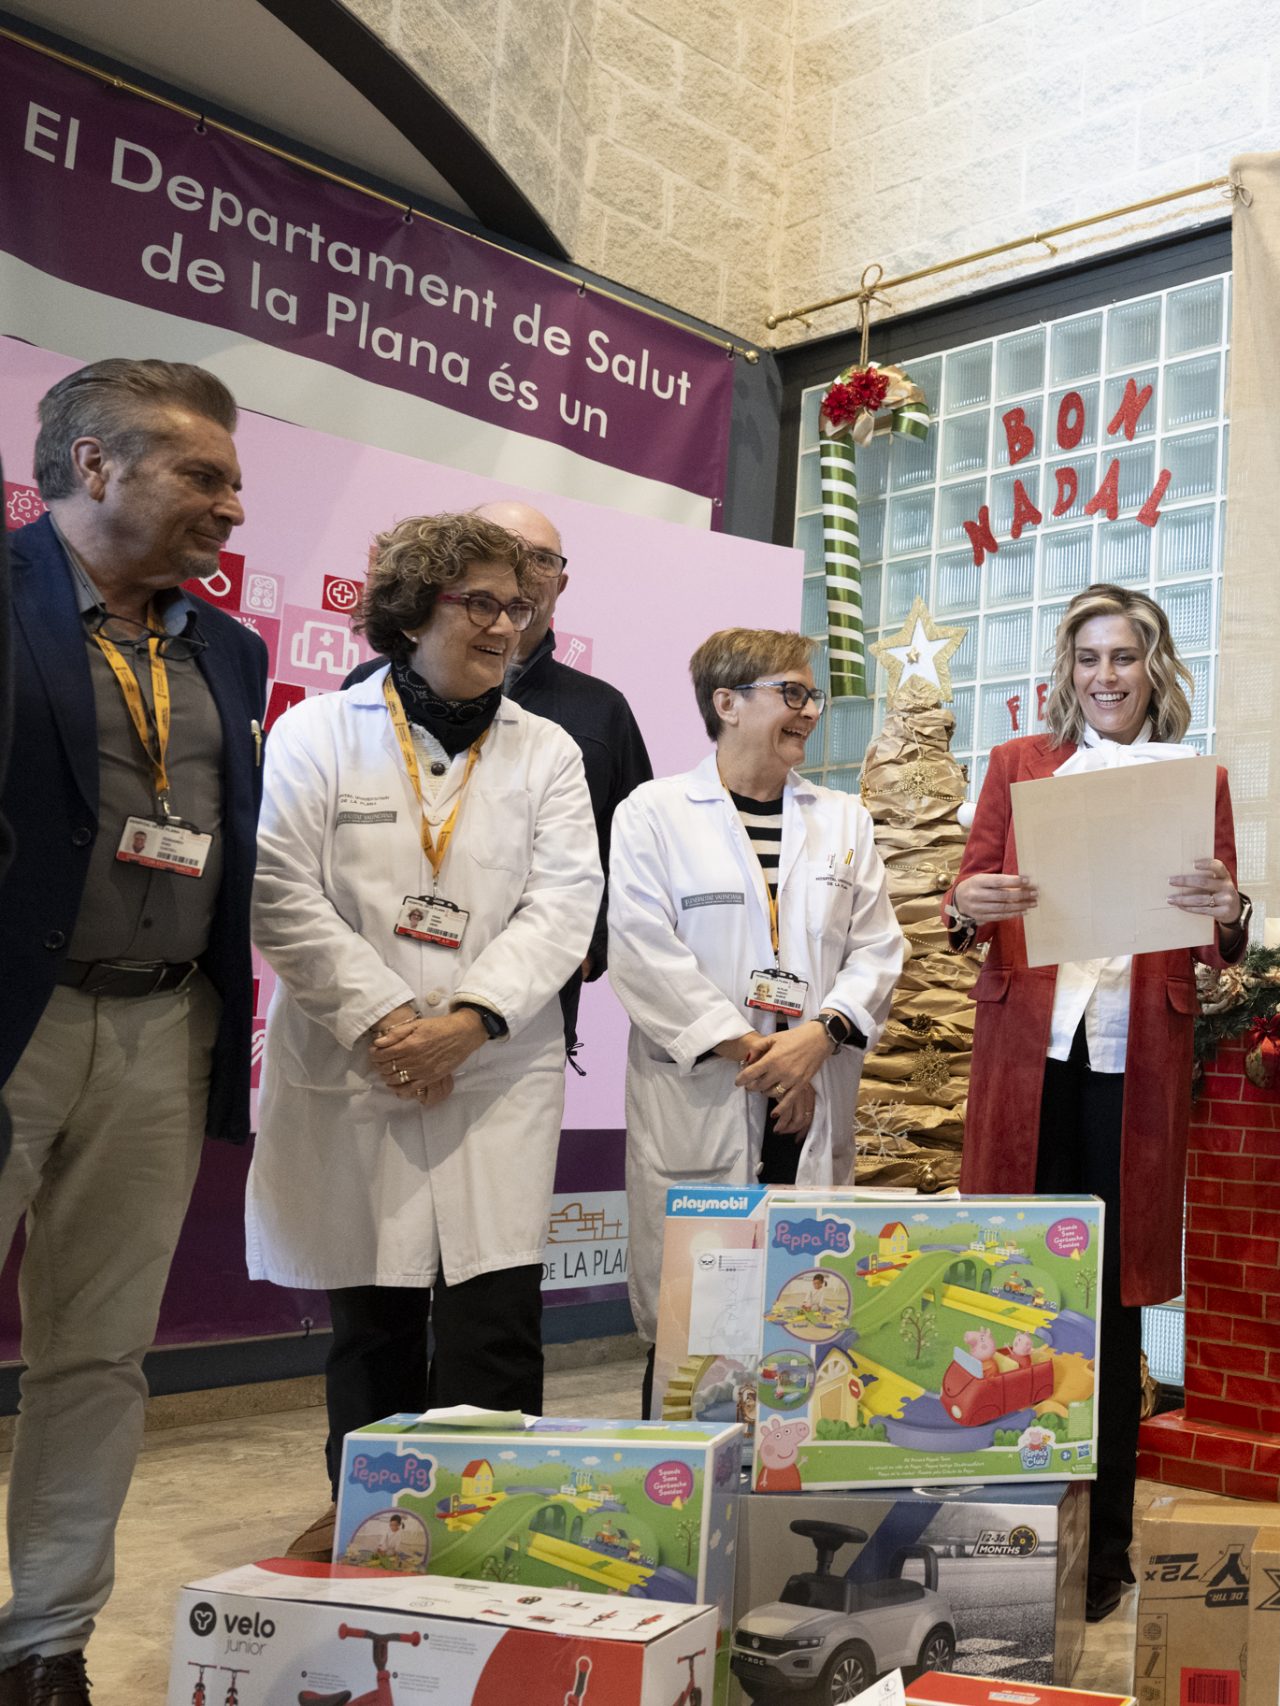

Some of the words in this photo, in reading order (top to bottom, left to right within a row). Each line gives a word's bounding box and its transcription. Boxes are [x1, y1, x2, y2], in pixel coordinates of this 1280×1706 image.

[23, 101, 79, 170] El
[110, 137, 496, 327] Departament
[513, 304, 572, 357] de
[586, 331, 691, 406] Salut
[141, 232, 226, 294] de
[251, 261, 298, 325] la
[326, 293, 470, 386] Plana
[489, 363, 539, 412] és
[559, 392, 608, 438] un
[1002, 378, 1153, 465] BON
[963, 459, 1171, 566] NADAL
[1006, 683, 1048, 730] FE
[672, 1196, 748, 1213] playmobil
[776, 1222, 822, 1252] Peppa
[824, 1222, 848, 1250] Pig
[542, 1263, 556, 1280] DE
[564, 1251, 587, 1279] LA
[353, 1455, 401, 1488] Peppa
[403, 1458, 428, 1490] Pig
[1026, 1458, 1046, 1468] Club
[979, 1545, 1021, 1554] MONTHS
[982, 1534, 1006, 1542] 12-36
[1230, 1592, 1244, 1600] DE
[224, 1611, 276, 1638] velo
[224, 1636, 267, 1656] junior
